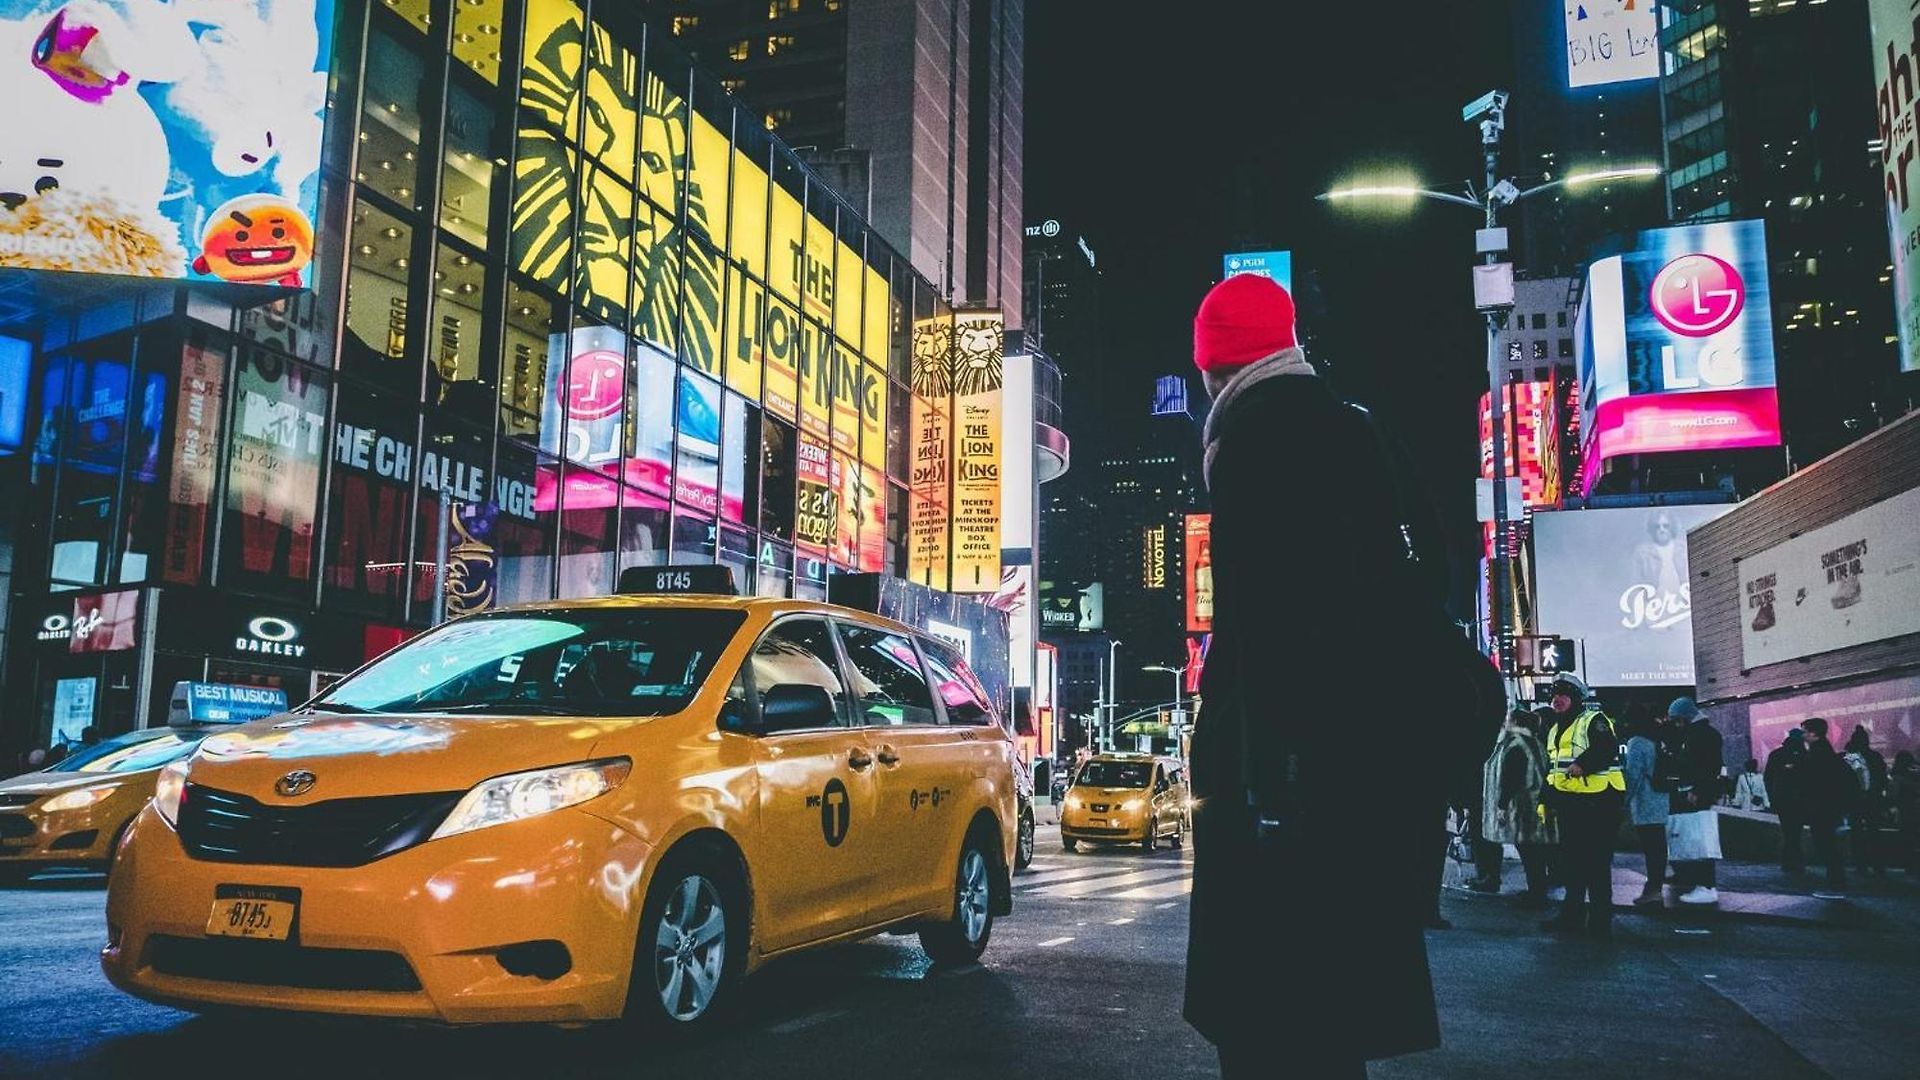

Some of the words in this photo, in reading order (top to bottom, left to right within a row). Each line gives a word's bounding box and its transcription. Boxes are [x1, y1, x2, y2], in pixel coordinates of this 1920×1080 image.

[1893, 110, 1912, 147] THE
[790, 238, 831, 307] THE
[738, 257, 810, 378] LION
[814, 316, 879, 421] KING
[1661, 345, 1745, 389] LG
[965, 424, 988, 436] THE
[961, 438, 993, 457] LION
[958, 458, 998, 481] KING
[1153, 525, 1164, 587] NOVOTEL
[656, 572, 691, 589] 8T45
[37, 630, 71, 640] OAKLEY
[236, 637, 304, 657] OAKLEY
[195, 685, 227, 700] BEST
[230, 687, 283, 704] MUSICAL
[208, 710, 229, 719] DEAR
